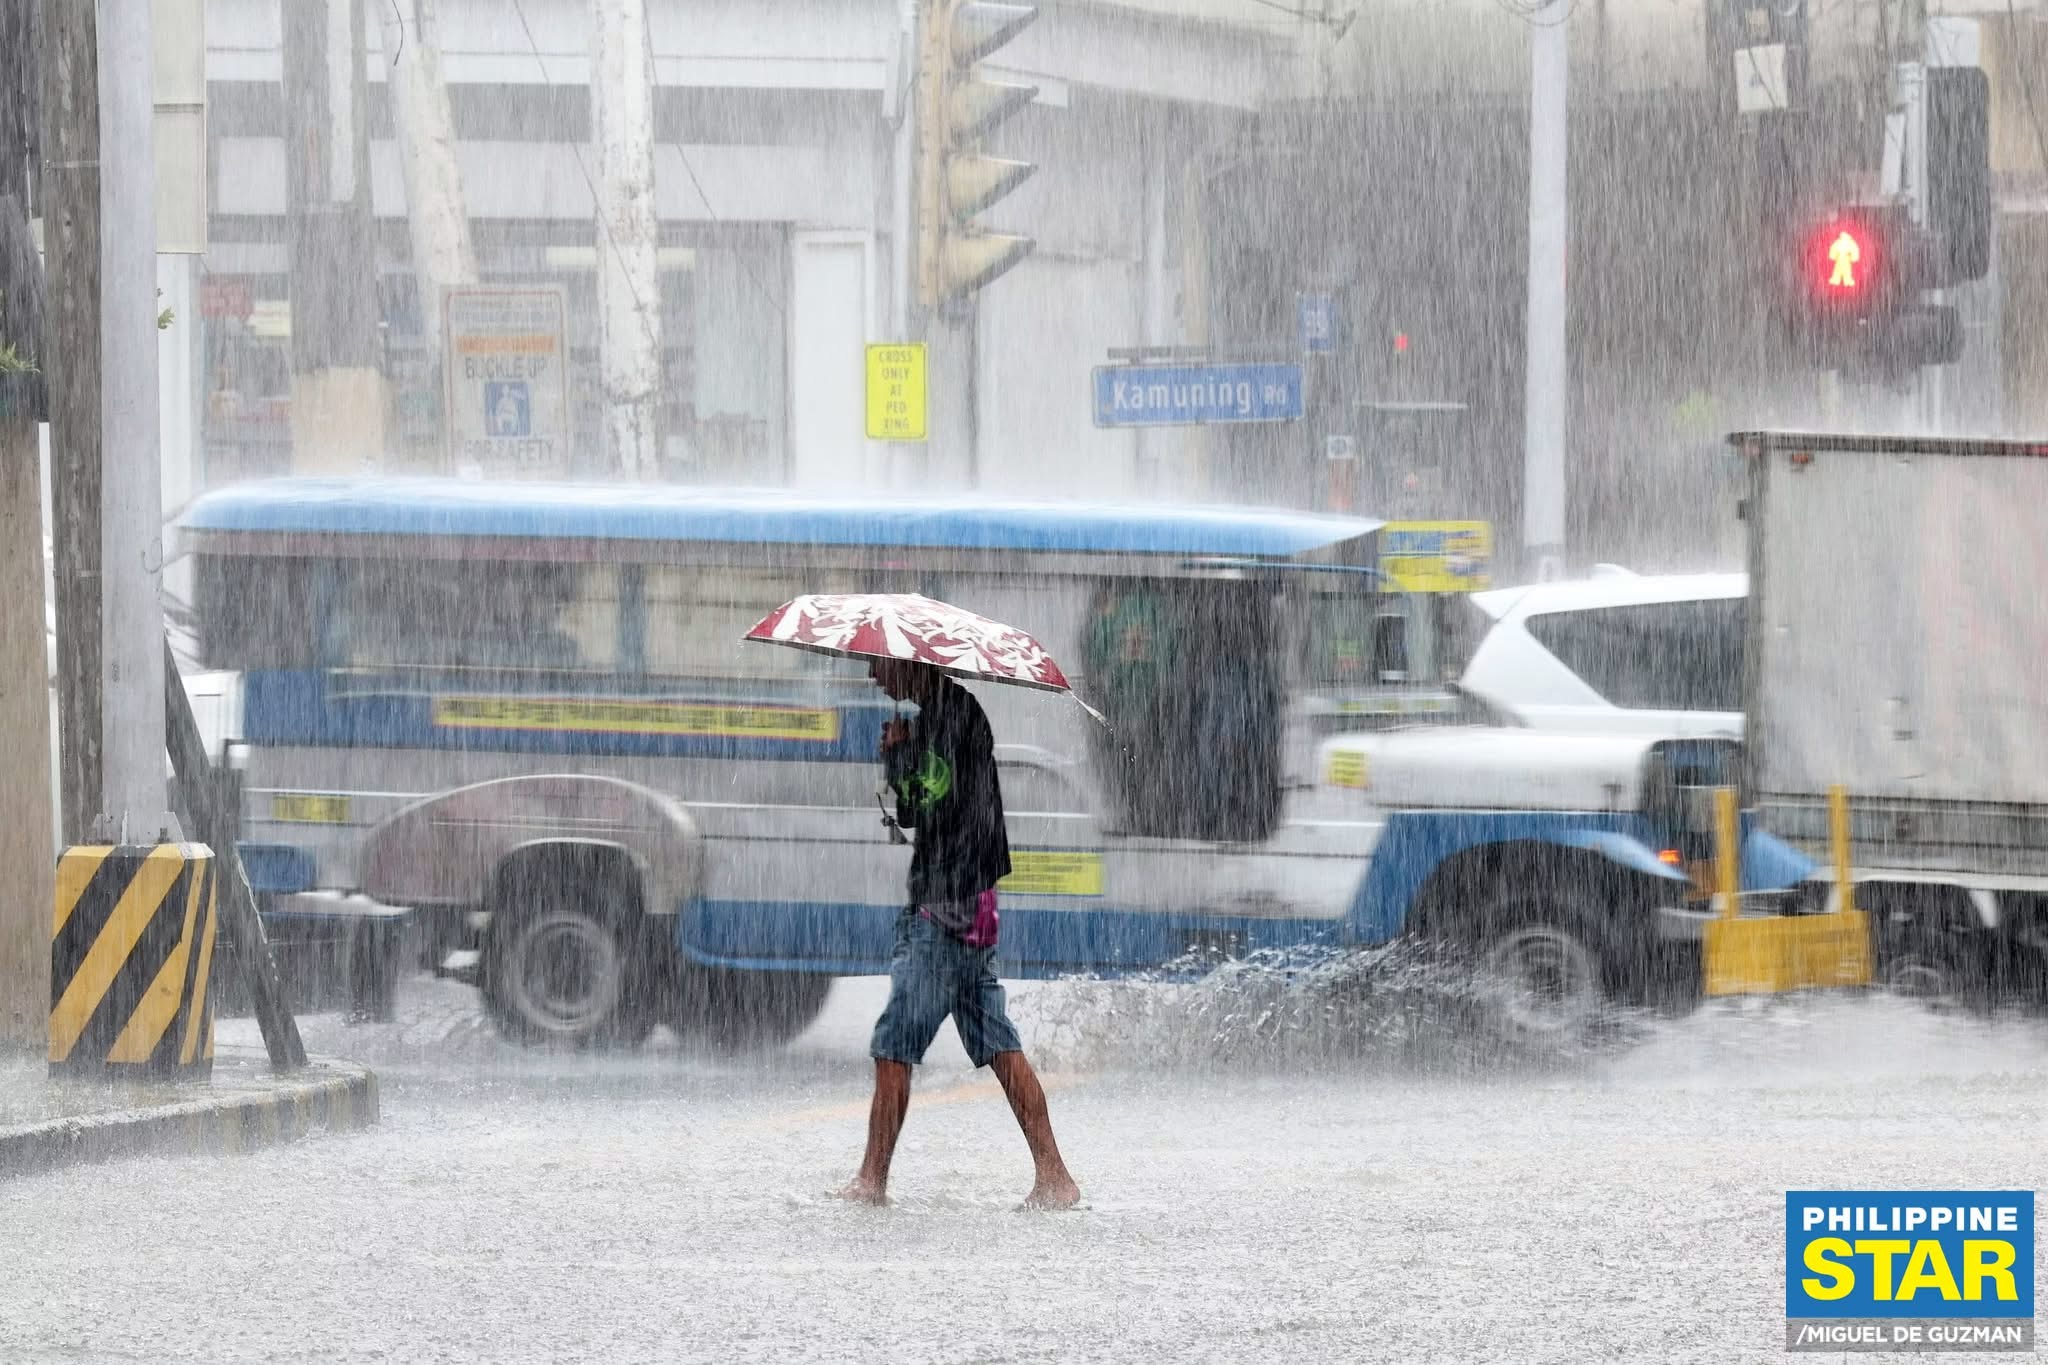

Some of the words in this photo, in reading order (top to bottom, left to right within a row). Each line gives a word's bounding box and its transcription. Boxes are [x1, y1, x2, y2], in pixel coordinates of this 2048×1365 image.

[879, 350, 914, 362] CROSS
[465, 357, 524, 379] BUCKLE
[881, 367, 911, 380] ONLY
[889, 384, 903, 397] AT
[1113, 375, 1251, 414] Kamuning
[886, 400, 908, 414] PED
[883, 417, 910, 431] XING
[496, 439, 555, 462] SAFETY
